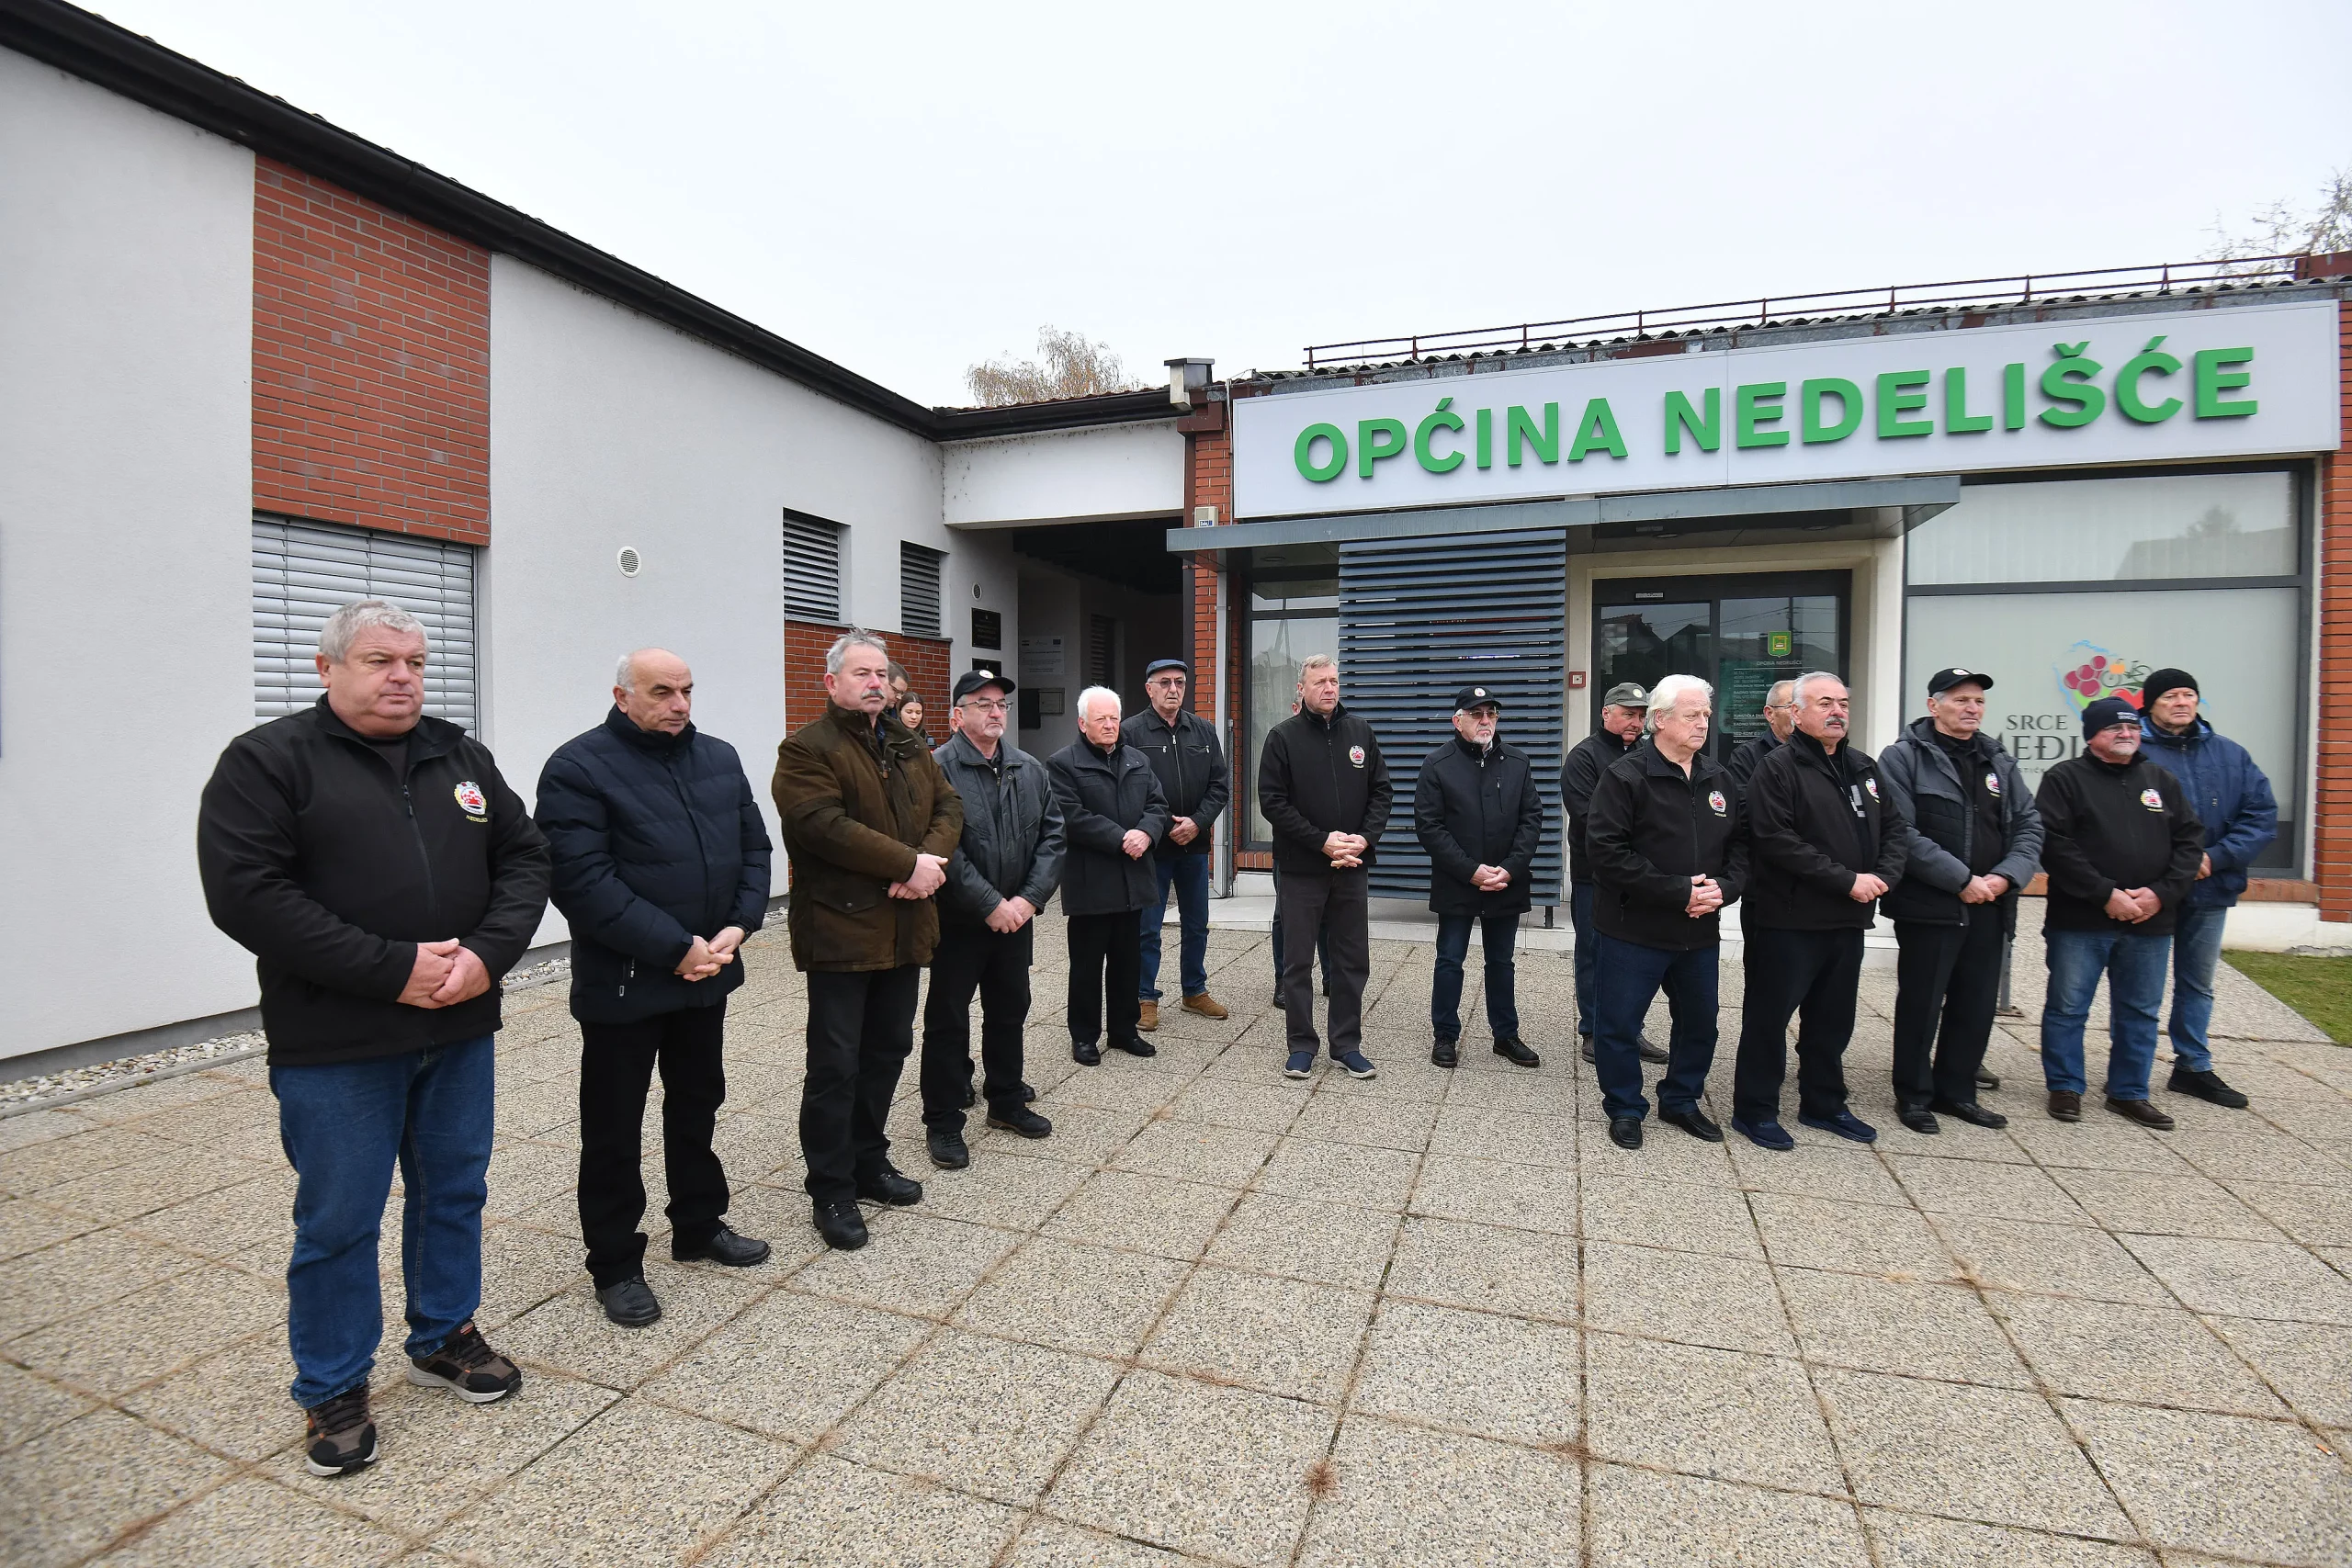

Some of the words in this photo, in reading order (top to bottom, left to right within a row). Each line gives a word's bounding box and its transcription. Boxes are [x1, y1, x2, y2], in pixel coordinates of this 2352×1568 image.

[1294, 397, 1629, 482] OPĆINA
[1664, 335, 2258, 454] NEDELIŠĆE
[2006, 714, 2068, 730] SRCE
